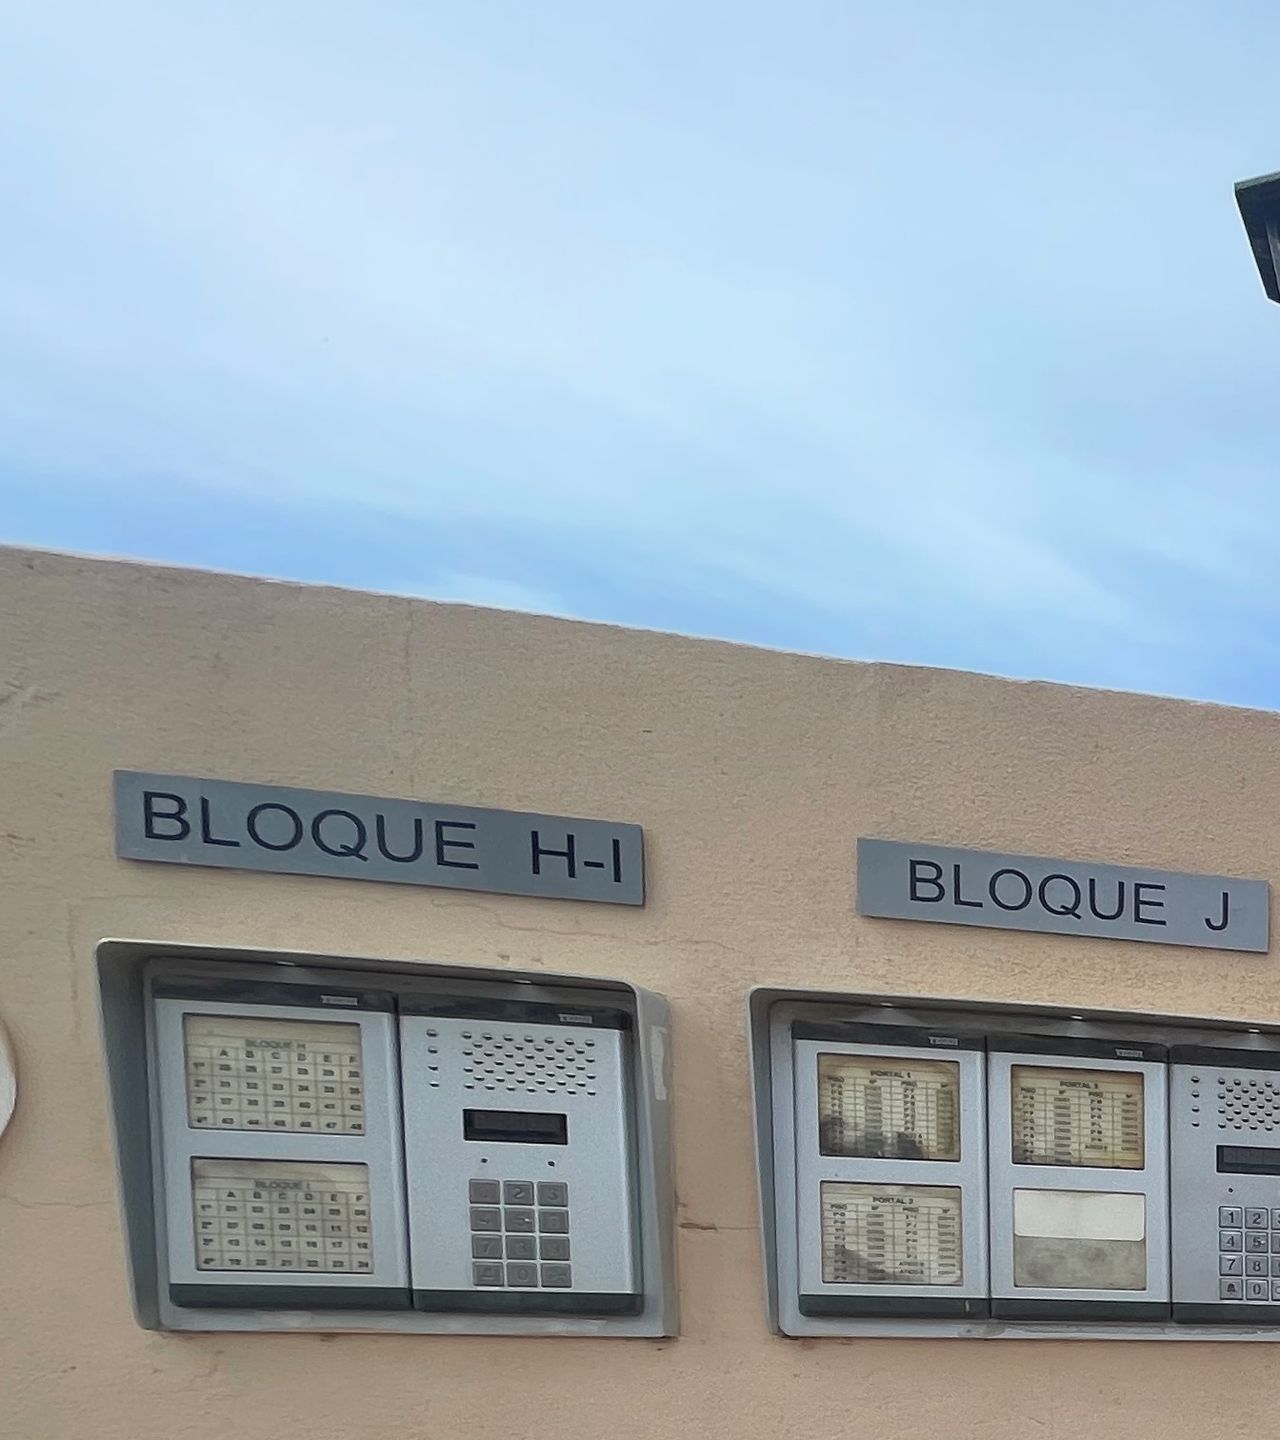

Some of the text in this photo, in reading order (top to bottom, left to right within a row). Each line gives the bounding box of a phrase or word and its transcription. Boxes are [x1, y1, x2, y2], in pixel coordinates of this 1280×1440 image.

[142, 790, 623, 883] BLOQUE H-I
[908, 858, 1231, 932] BLOQUE J
[1229, 1212, 1234, 1223] 1
[1252, 1212, 1261, 1225] 2
[1226, 1236, 1234, 1247] 4
[1227, 1259, 1236, 1270] 7
[1253, 1260, 1261, 1271] 8
[1253, 1284, 1261, 1295] 0
